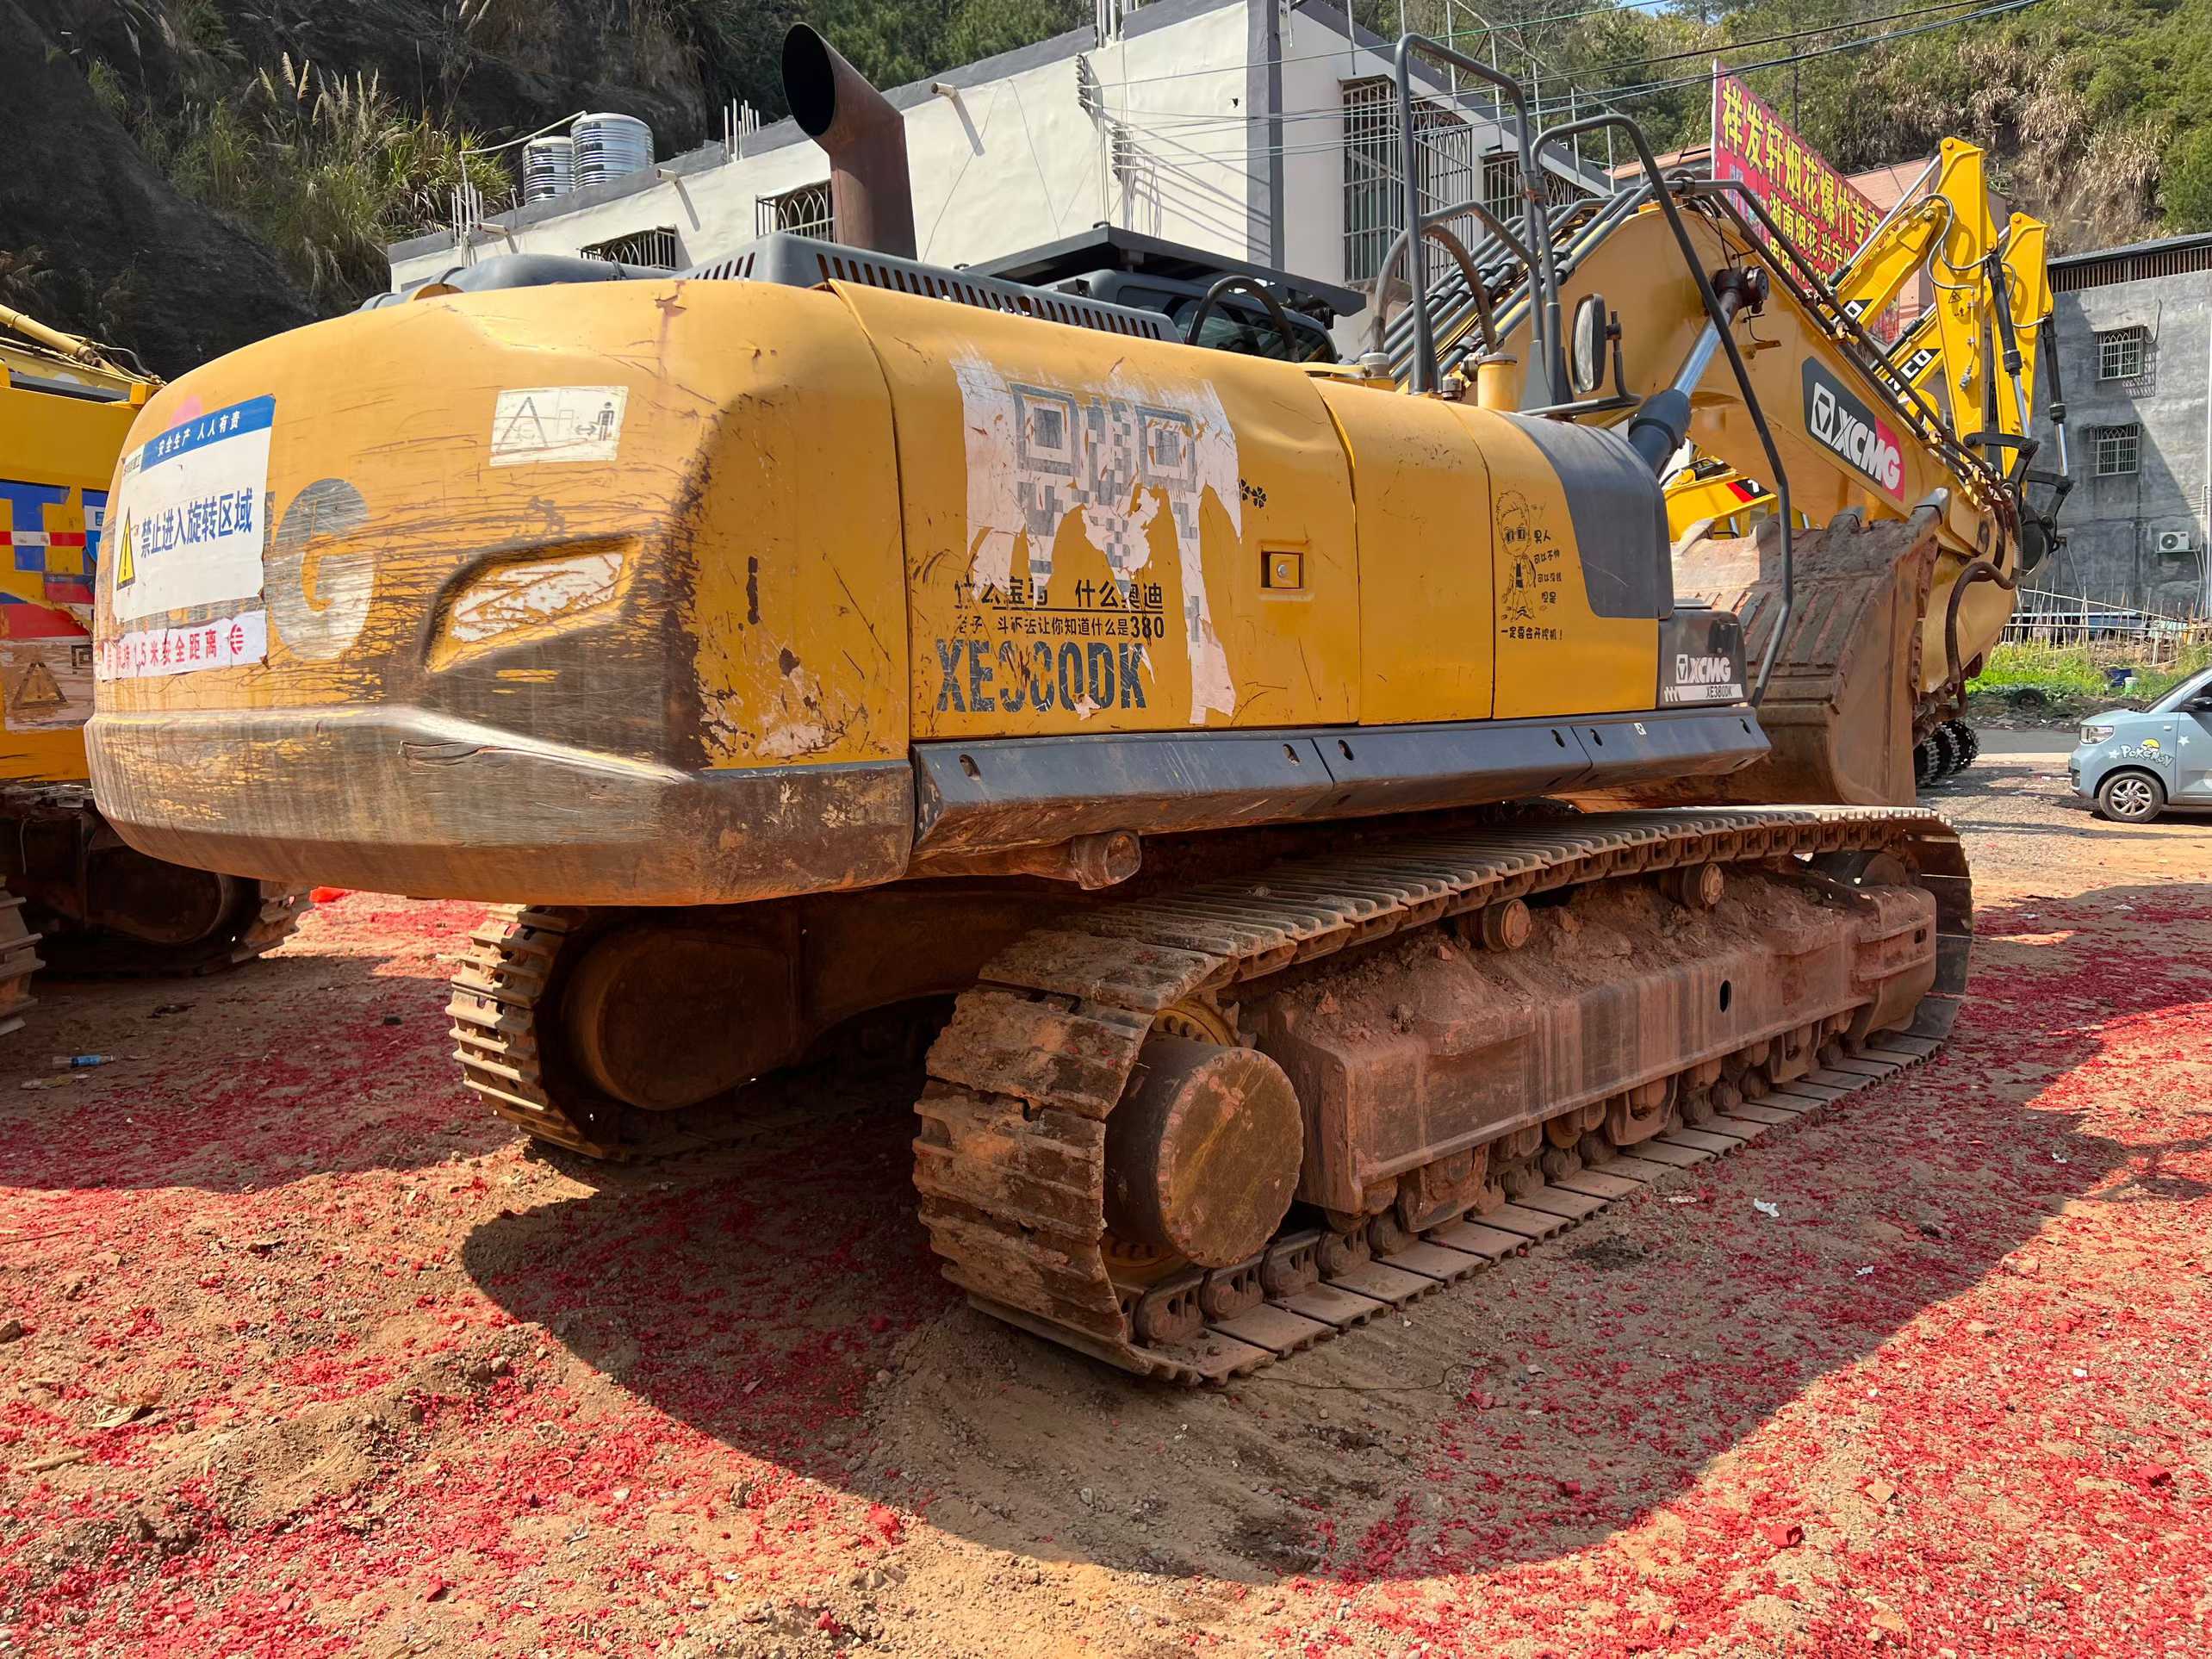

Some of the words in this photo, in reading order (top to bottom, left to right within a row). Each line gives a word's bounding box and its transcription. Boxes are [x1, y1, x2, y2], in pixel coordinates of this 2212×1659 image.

[158, 428, 190, 457] 安全生产
[196, 411, 240, 441] 人人有责
[1830, 406, 1900, 490] XCMG
[140, 487, 252, 558] 禁止进入旋转区域
[1075, 580, 1163, 609] 什么奥迪
[1688, 657, 1731, 683] XCMG
